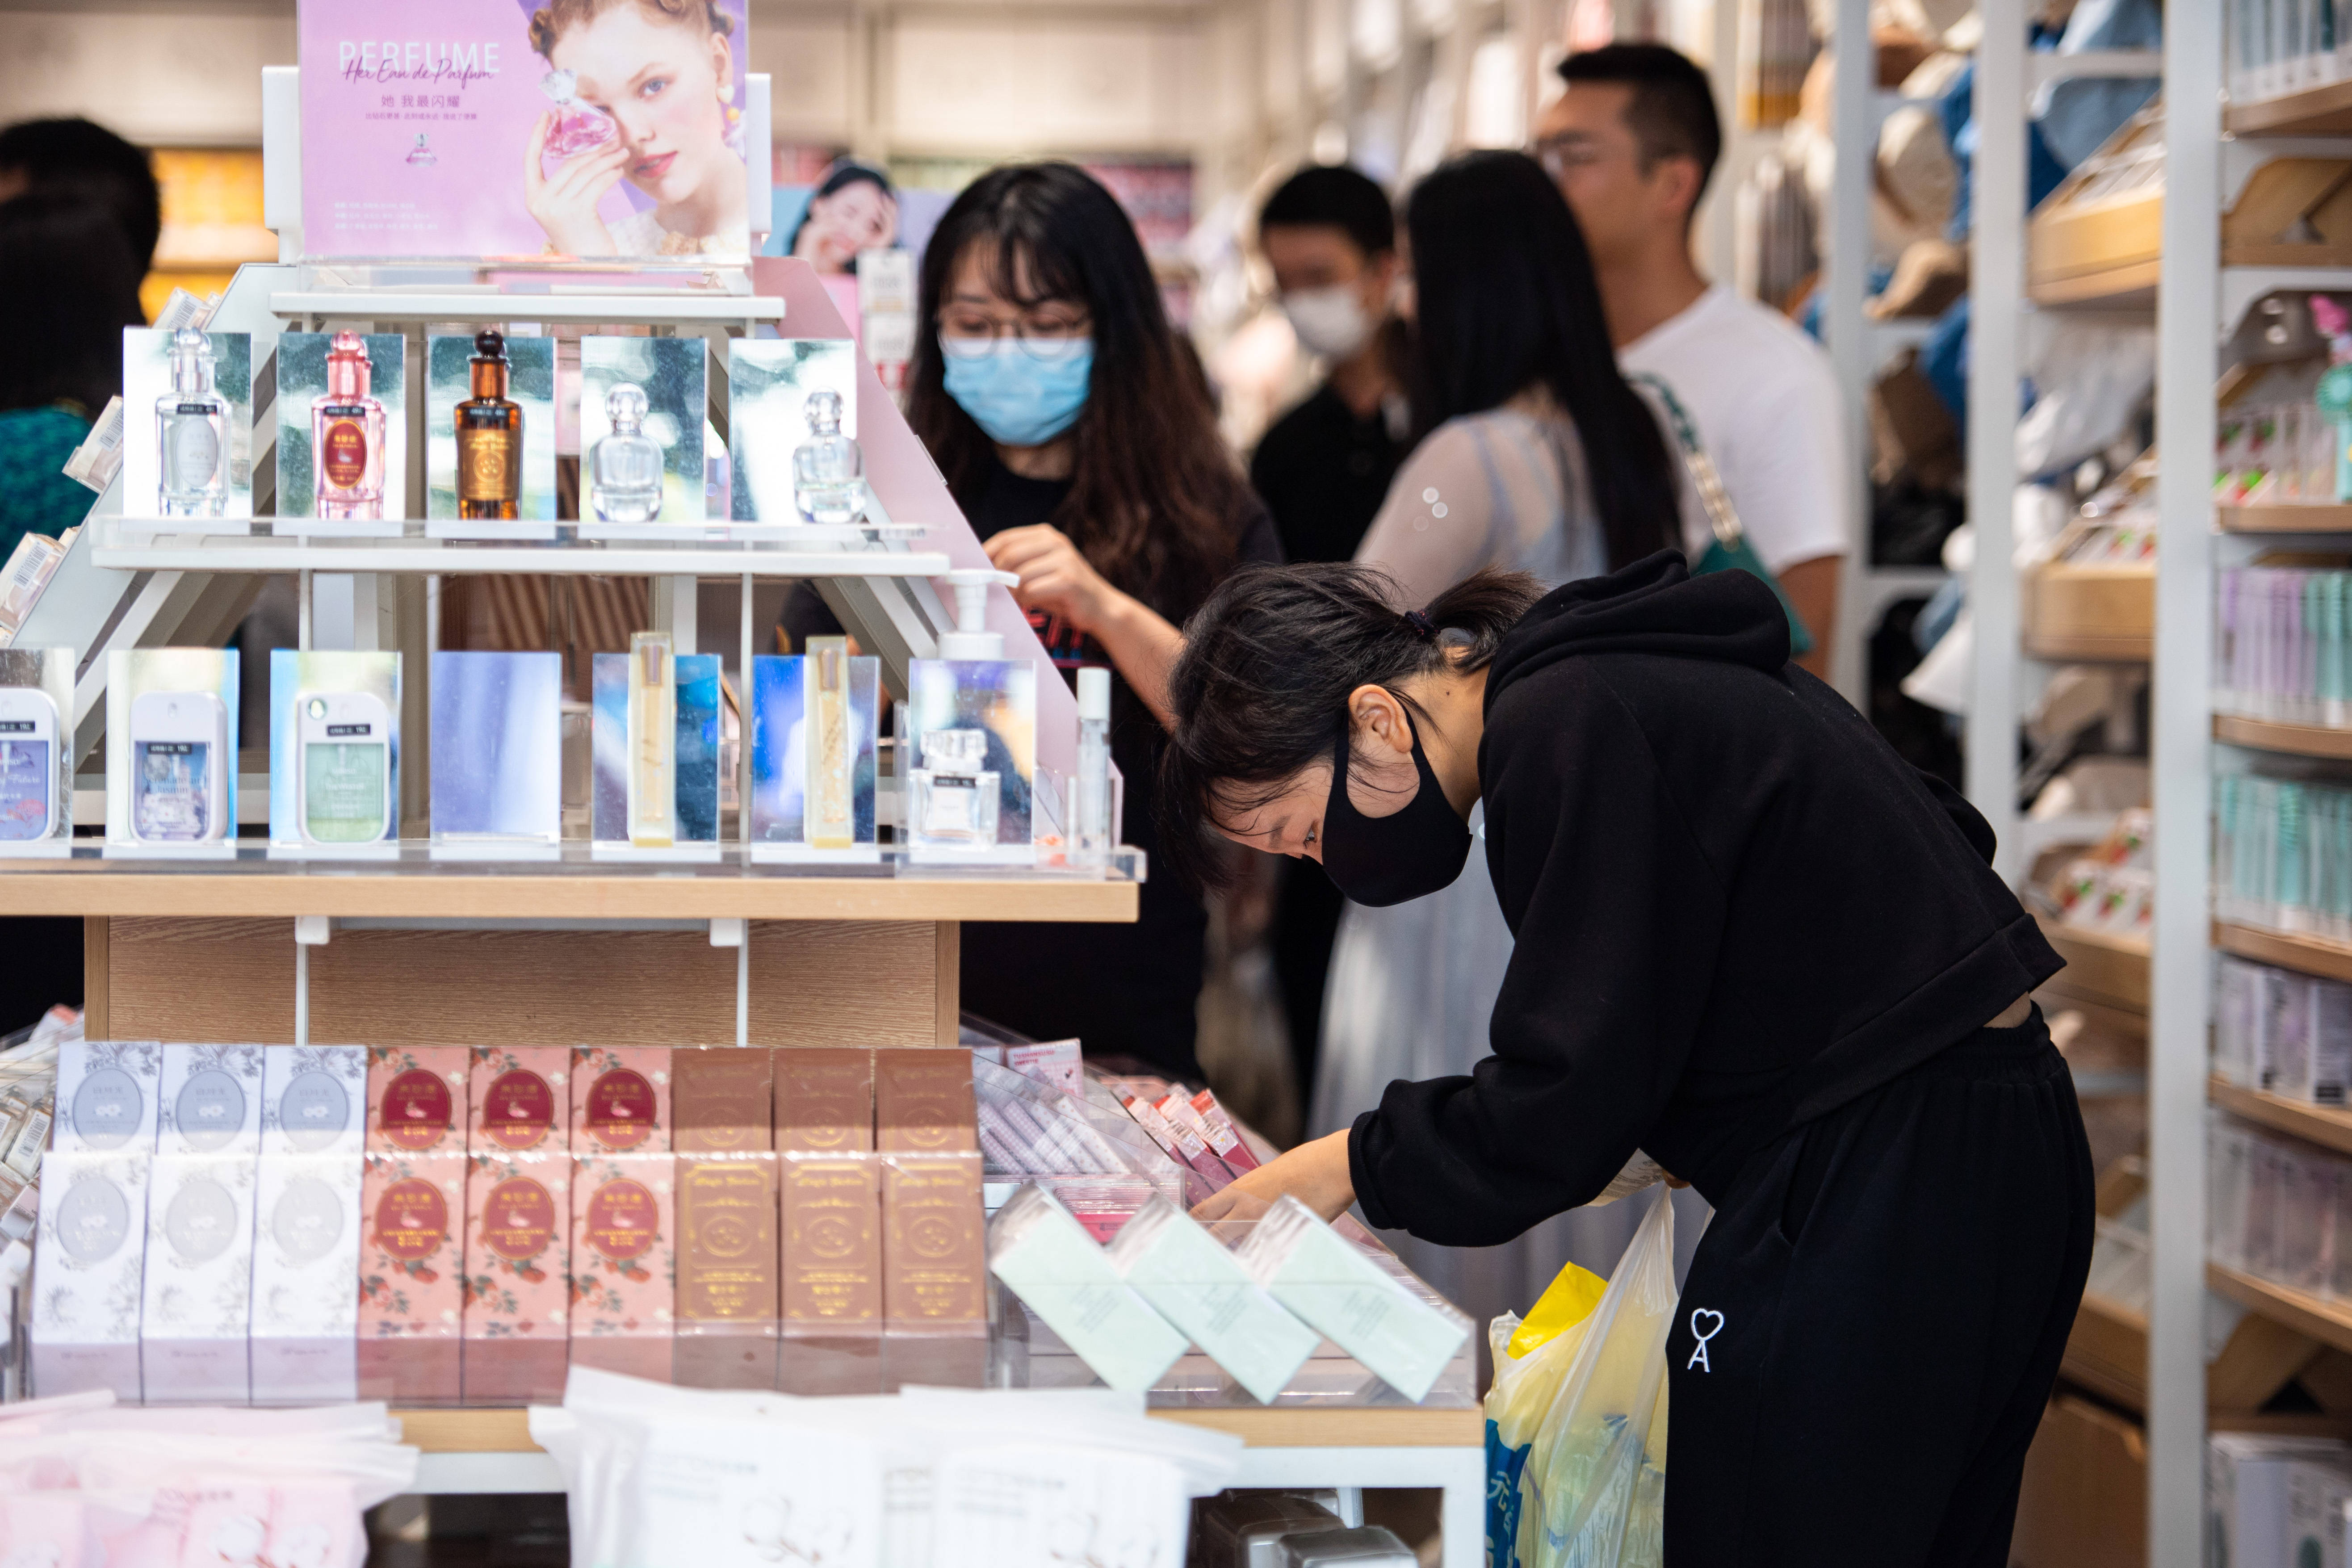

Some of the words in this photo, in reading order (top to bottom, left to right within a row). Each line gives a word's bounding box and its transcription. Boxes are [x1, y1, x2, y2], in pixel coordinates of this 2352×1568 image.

[339, 41, 500, 72] PERFUME
[342, 55, 375, 84] Her
[377, 58, 409, 83] Eau
[412, 63, 431, 80] de
[432, 58, 493, 89] Parfum
[382, 95, 394, 107] 她
[402, 95, 460, 108] 我最闪耀
